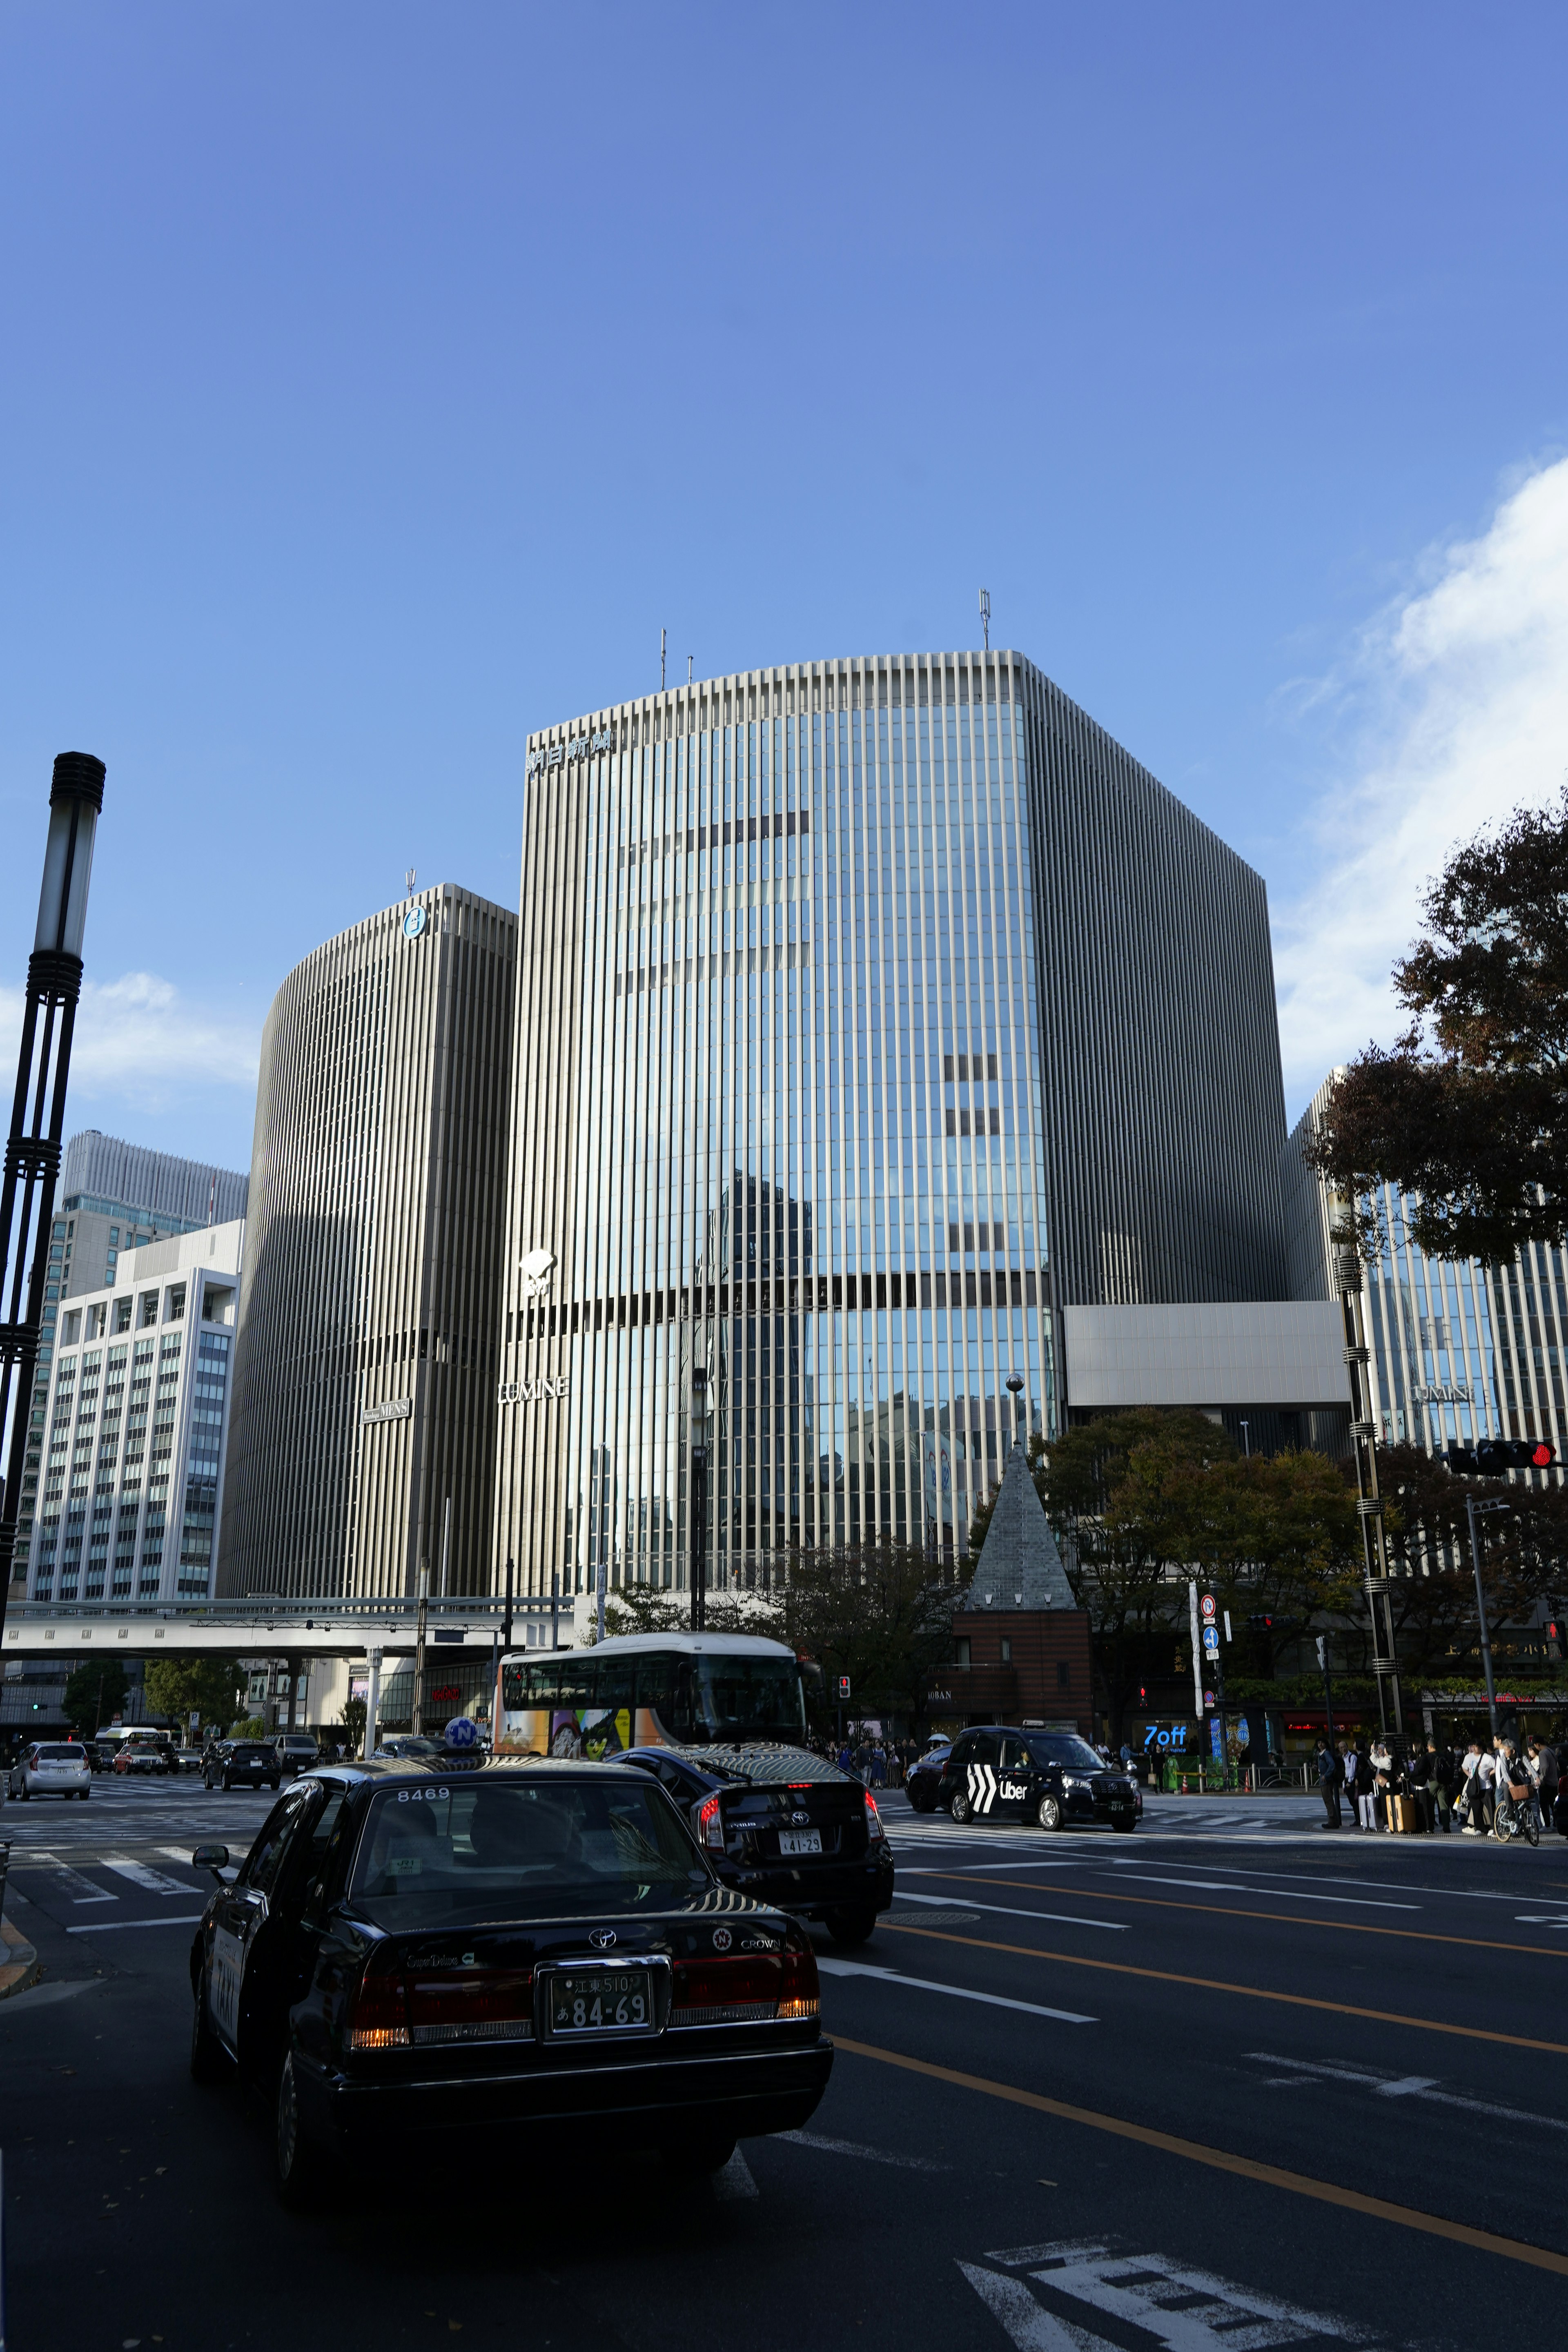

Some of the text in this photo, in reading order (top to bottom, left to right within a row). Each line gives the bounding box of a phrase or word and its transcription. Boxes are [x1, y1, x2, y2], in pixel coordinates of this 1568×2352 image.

[525, 728, 611, 777] 朝日新聞
[498, 1376, 568, 1403] LUMINE
[1406, 1385, 1476, 1401] LUMINE
[364, 1411, 379, 1420] Hankyu
[928, 1690, 951, 1699] KOBAN
[458, 1726, 471, 1740] N
[1144, 1726, 1186, 1746] Zoff
[398, 1787, 449, 1802] 8469
[1000, 1780, 1028, 1800] Uber
[790, 1839, 820, 1852] 41-29
[719, 1935, 726, 1944] N
[741, 1939, 780, 1950] CROWN
[407, 1954, 459, 1970] Super Deluxe
[217, 1958, 235, 2031] TAXI
[557, 1994, 645, 2027] あ 84-69
